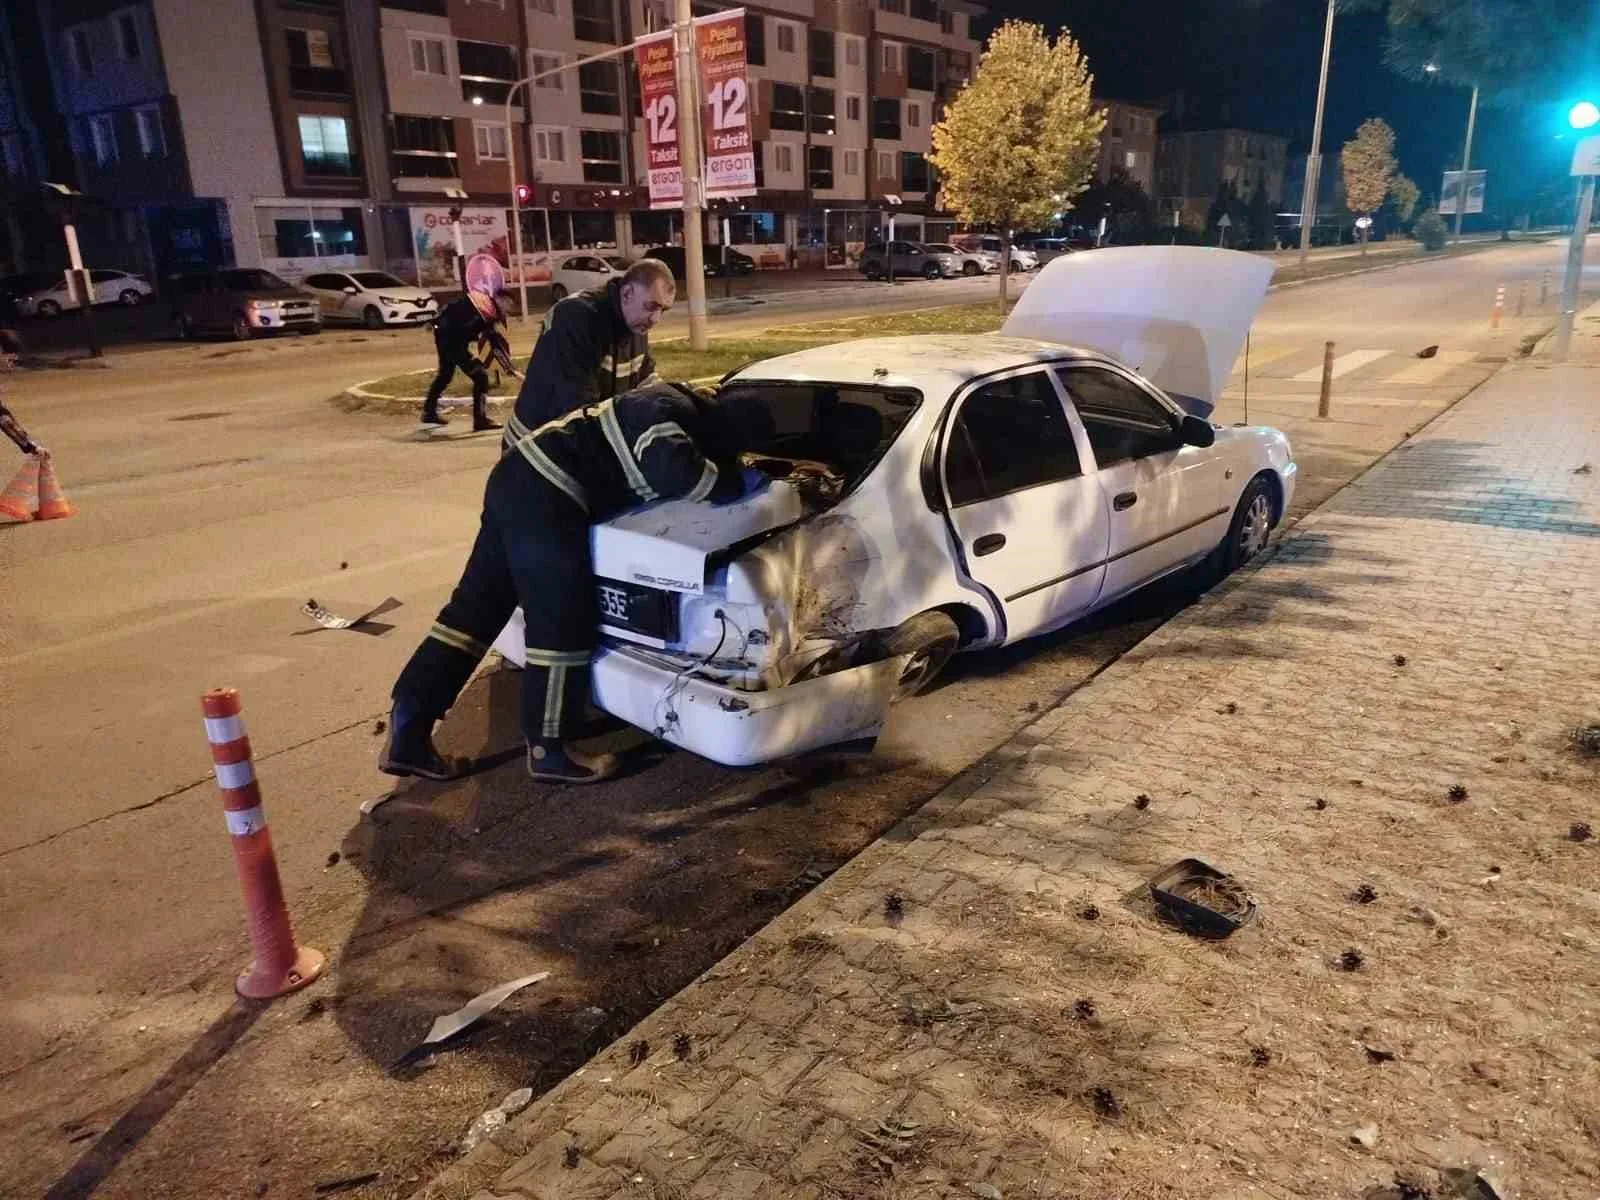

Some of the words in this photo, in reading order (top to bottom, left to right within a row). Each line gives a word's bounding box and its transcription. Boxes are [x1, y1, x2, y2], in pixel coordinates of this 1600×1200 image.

[646, 94, 676, 144] 12
[708, 77, 746, 130] 12
[651, 147, 678, 163] Taksit
[713, 132, 748, 150] Taksit
